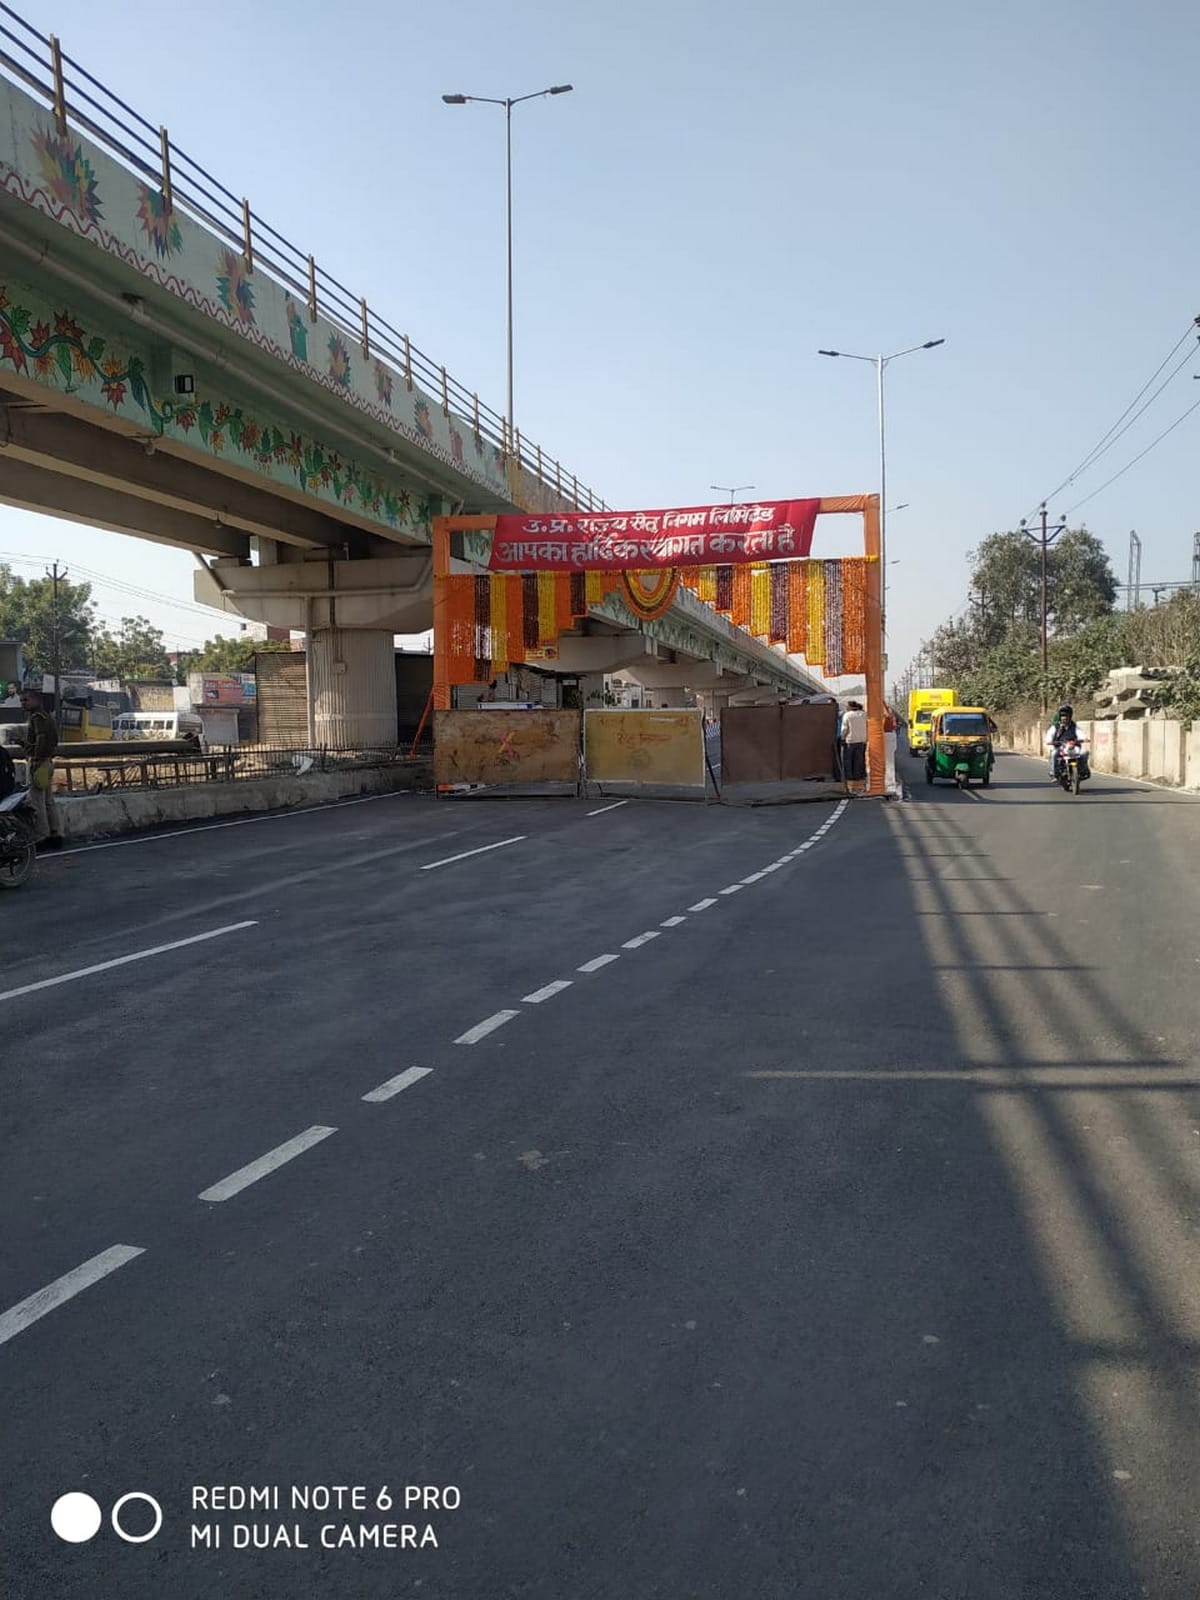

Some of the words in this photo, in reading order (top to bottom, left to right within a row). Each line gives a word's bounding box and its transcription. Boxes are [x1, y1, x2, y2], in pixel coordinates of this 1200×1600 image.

[577, 516, 628, 536] राज्य
[629, 512, 661, 534] सेतु
[662, 510, 707, 529] निगम
[709, 504, 776, 526] लिमिटेड
[495, 541, 568, 563] आपका
[571, 531, 639, 567] हार्दिक
[709, 529, 777, 557] करता
[777, 522, 796, 553] है
